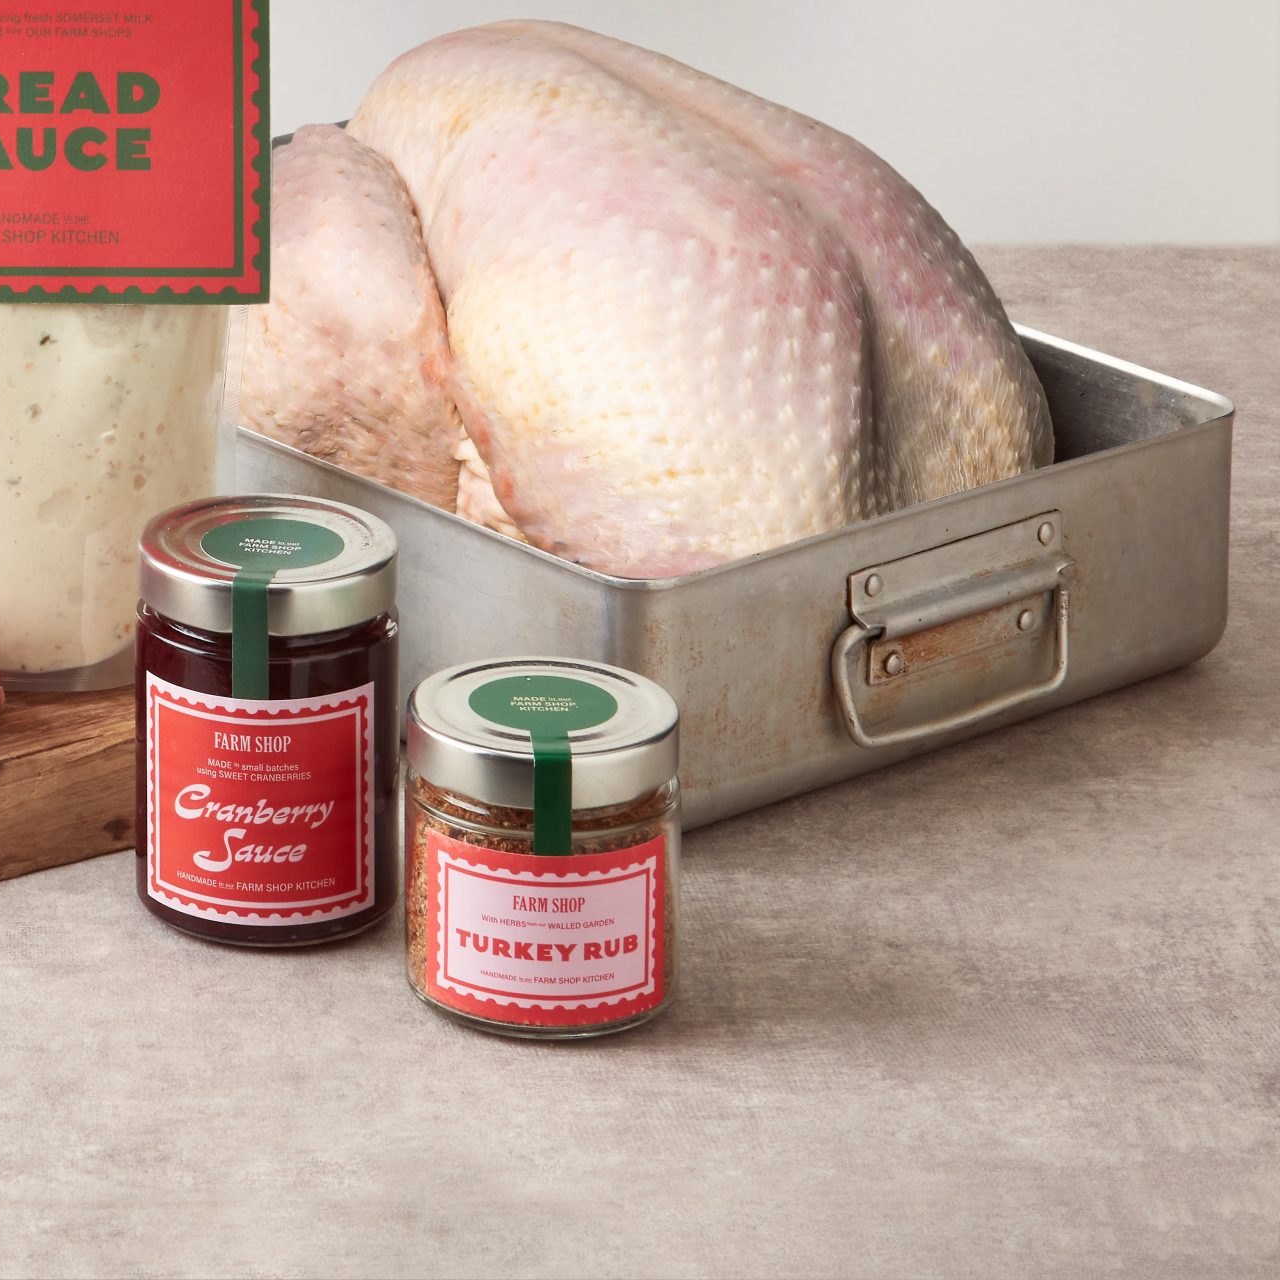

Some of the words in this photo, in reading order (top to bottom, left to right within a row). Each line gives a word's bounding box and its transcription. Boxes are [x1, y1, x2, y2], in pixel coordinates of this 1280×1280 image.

[24, 12, 52, 23] fresh
[55, 12, 120, 24] SOMERSET
[123, 13, 153, 24] MILK
[55, 27, 88, 38] FARM
[91, 27, 132, 39] SHOPS
[2, 230, 46, 244] SHOP
[51, 230, 120, 244] KITCHEN
[244, 547, 291, 555] KITCHEN
[213, 731, 251, 752] FARM
[255, 735, 292, 753] SHOP
[207, 757, 233, 770] MADE
[241, 763, 264, 772] small
[265, 763, 299, 772] batches
[196, 767, 217, 779] using
[218, 770, 248, 781] SWEET
[250, 771, 312, 782] CRANBERRIES
[174, 783, 335, 829] Cranberry
[192, 827, 307, 872] Sauce
[176, 870, 217, 888] HANDMADE
[236, 883, 264, 892] FARM
[266, 883, 293, 892] SHOP
[295, 877, 336, 891] KITCHEN
[513, 895, 548, 913] FARM
[552, 897, 586, 914] SHOP
[481, 914, 498, 924] With
[499, 918, 527, 928] HERBS
[547, 922, 581, 930] WALLED
[582, 918, 615, 929] GARDEN
[455, 928, 578, 962] TURKEY
[583, 934, 639, 961] RUB
[480, 970, 517, 982] HANDMADE
[533, 976, 557, 985] FARM
[558, 976, 581, 985] SHOP
[582, 973, 615, 985] KITCHEN
